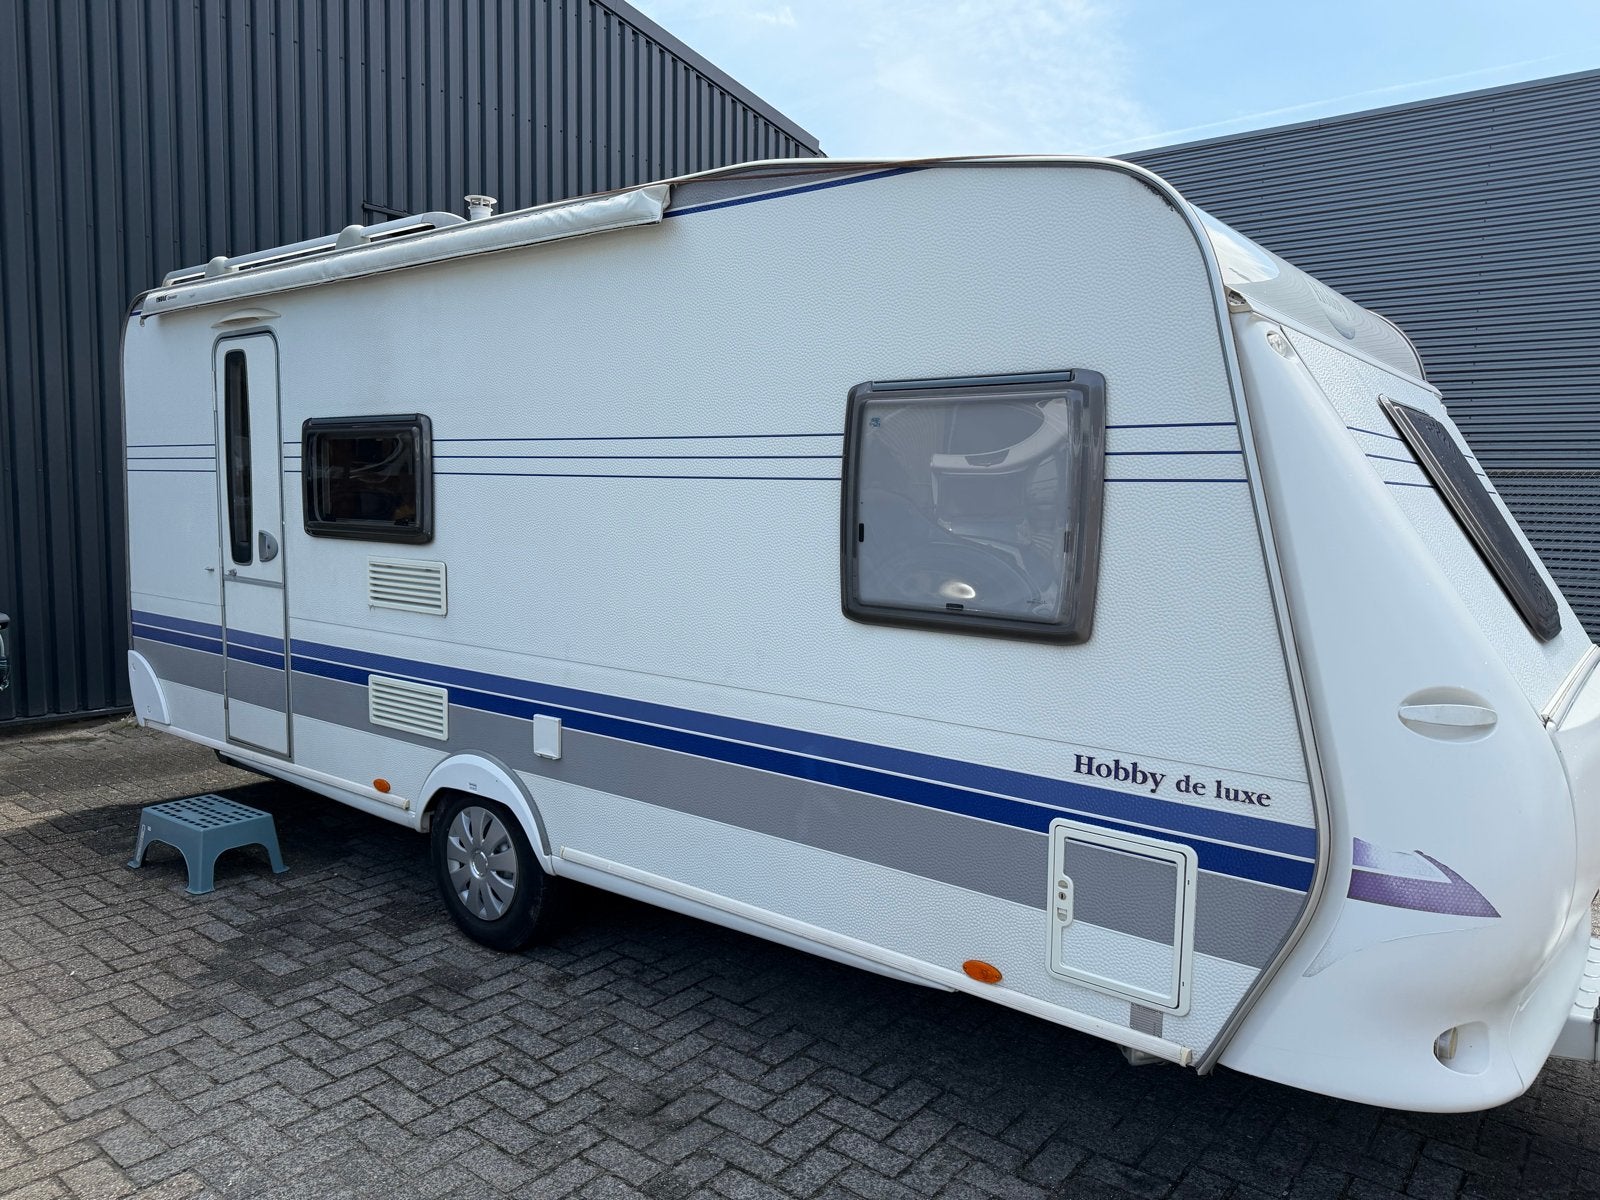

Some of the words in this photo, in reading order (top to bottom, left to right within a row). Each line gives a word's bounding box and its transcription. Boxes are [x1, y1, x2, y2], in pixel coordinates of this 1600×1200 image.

[1073, 753, 1167, 794] Hobby
[1175, 774, 1206, 796] de
[1214, 779, 1272, 807] luxe
